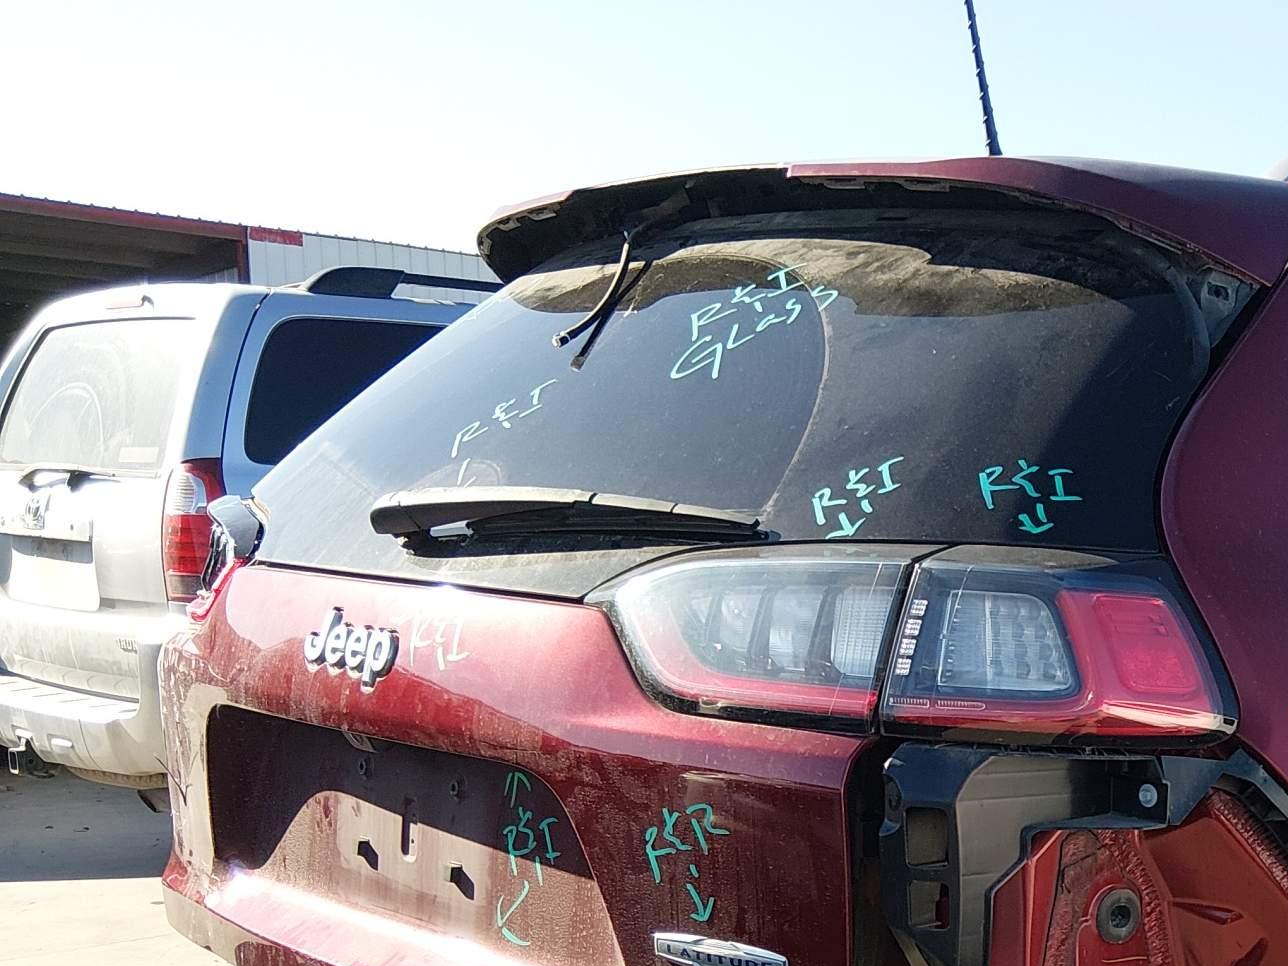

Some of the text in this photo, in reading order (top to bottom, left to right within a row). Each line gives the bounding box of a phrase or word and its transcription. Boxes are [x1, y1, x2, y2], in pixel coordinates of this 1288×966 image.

[691, 263, 808, 341] R&I
[451, 379, 558, 458] R&I
[811, 456, 904, 526] R&I
[979, 459, 1083, 523] R&I
[304, 606, 399, 690] Jeep
